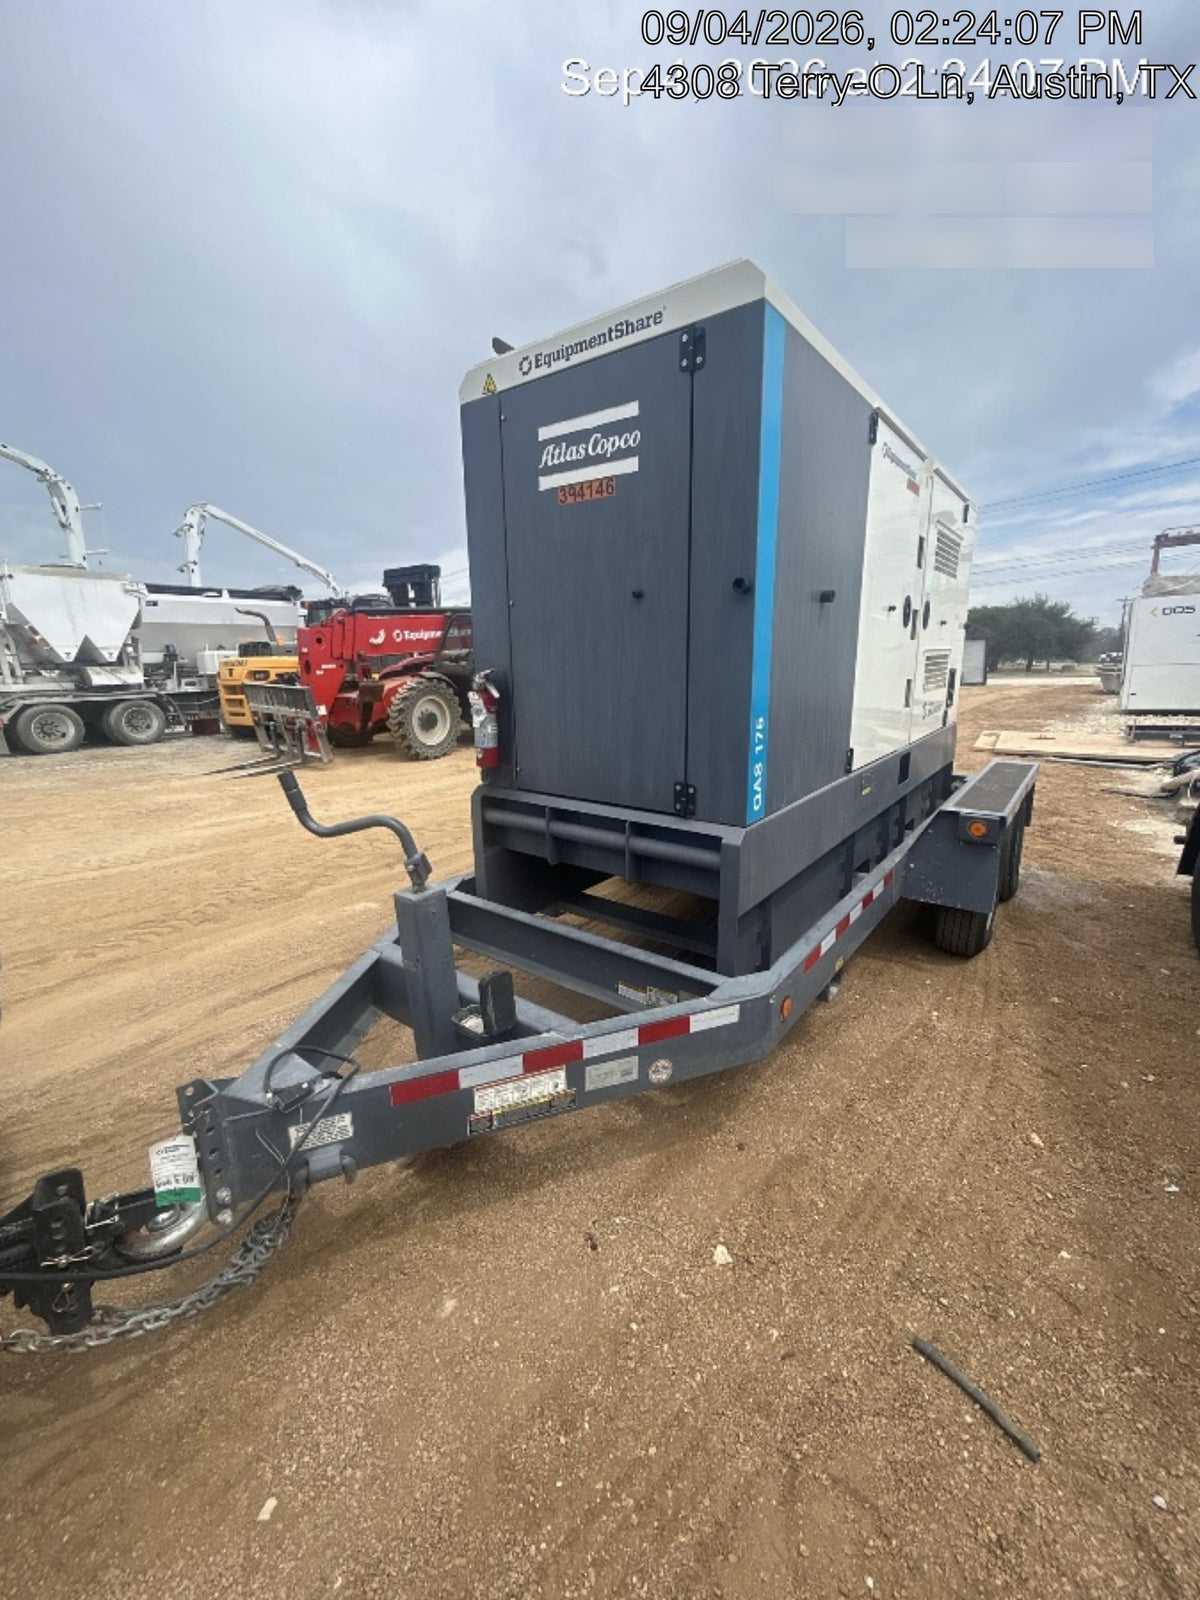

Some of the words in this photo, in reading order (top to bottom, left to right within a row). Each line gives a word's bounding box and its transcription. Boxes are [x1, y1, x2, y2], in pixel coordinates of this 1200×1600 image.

[534, 310, 663, 368] EquipmentShare
[538, 442, 587, 468] Atlas
[588, 429, 641, 458] Copco
[559, 478, 615, 504] 394146
